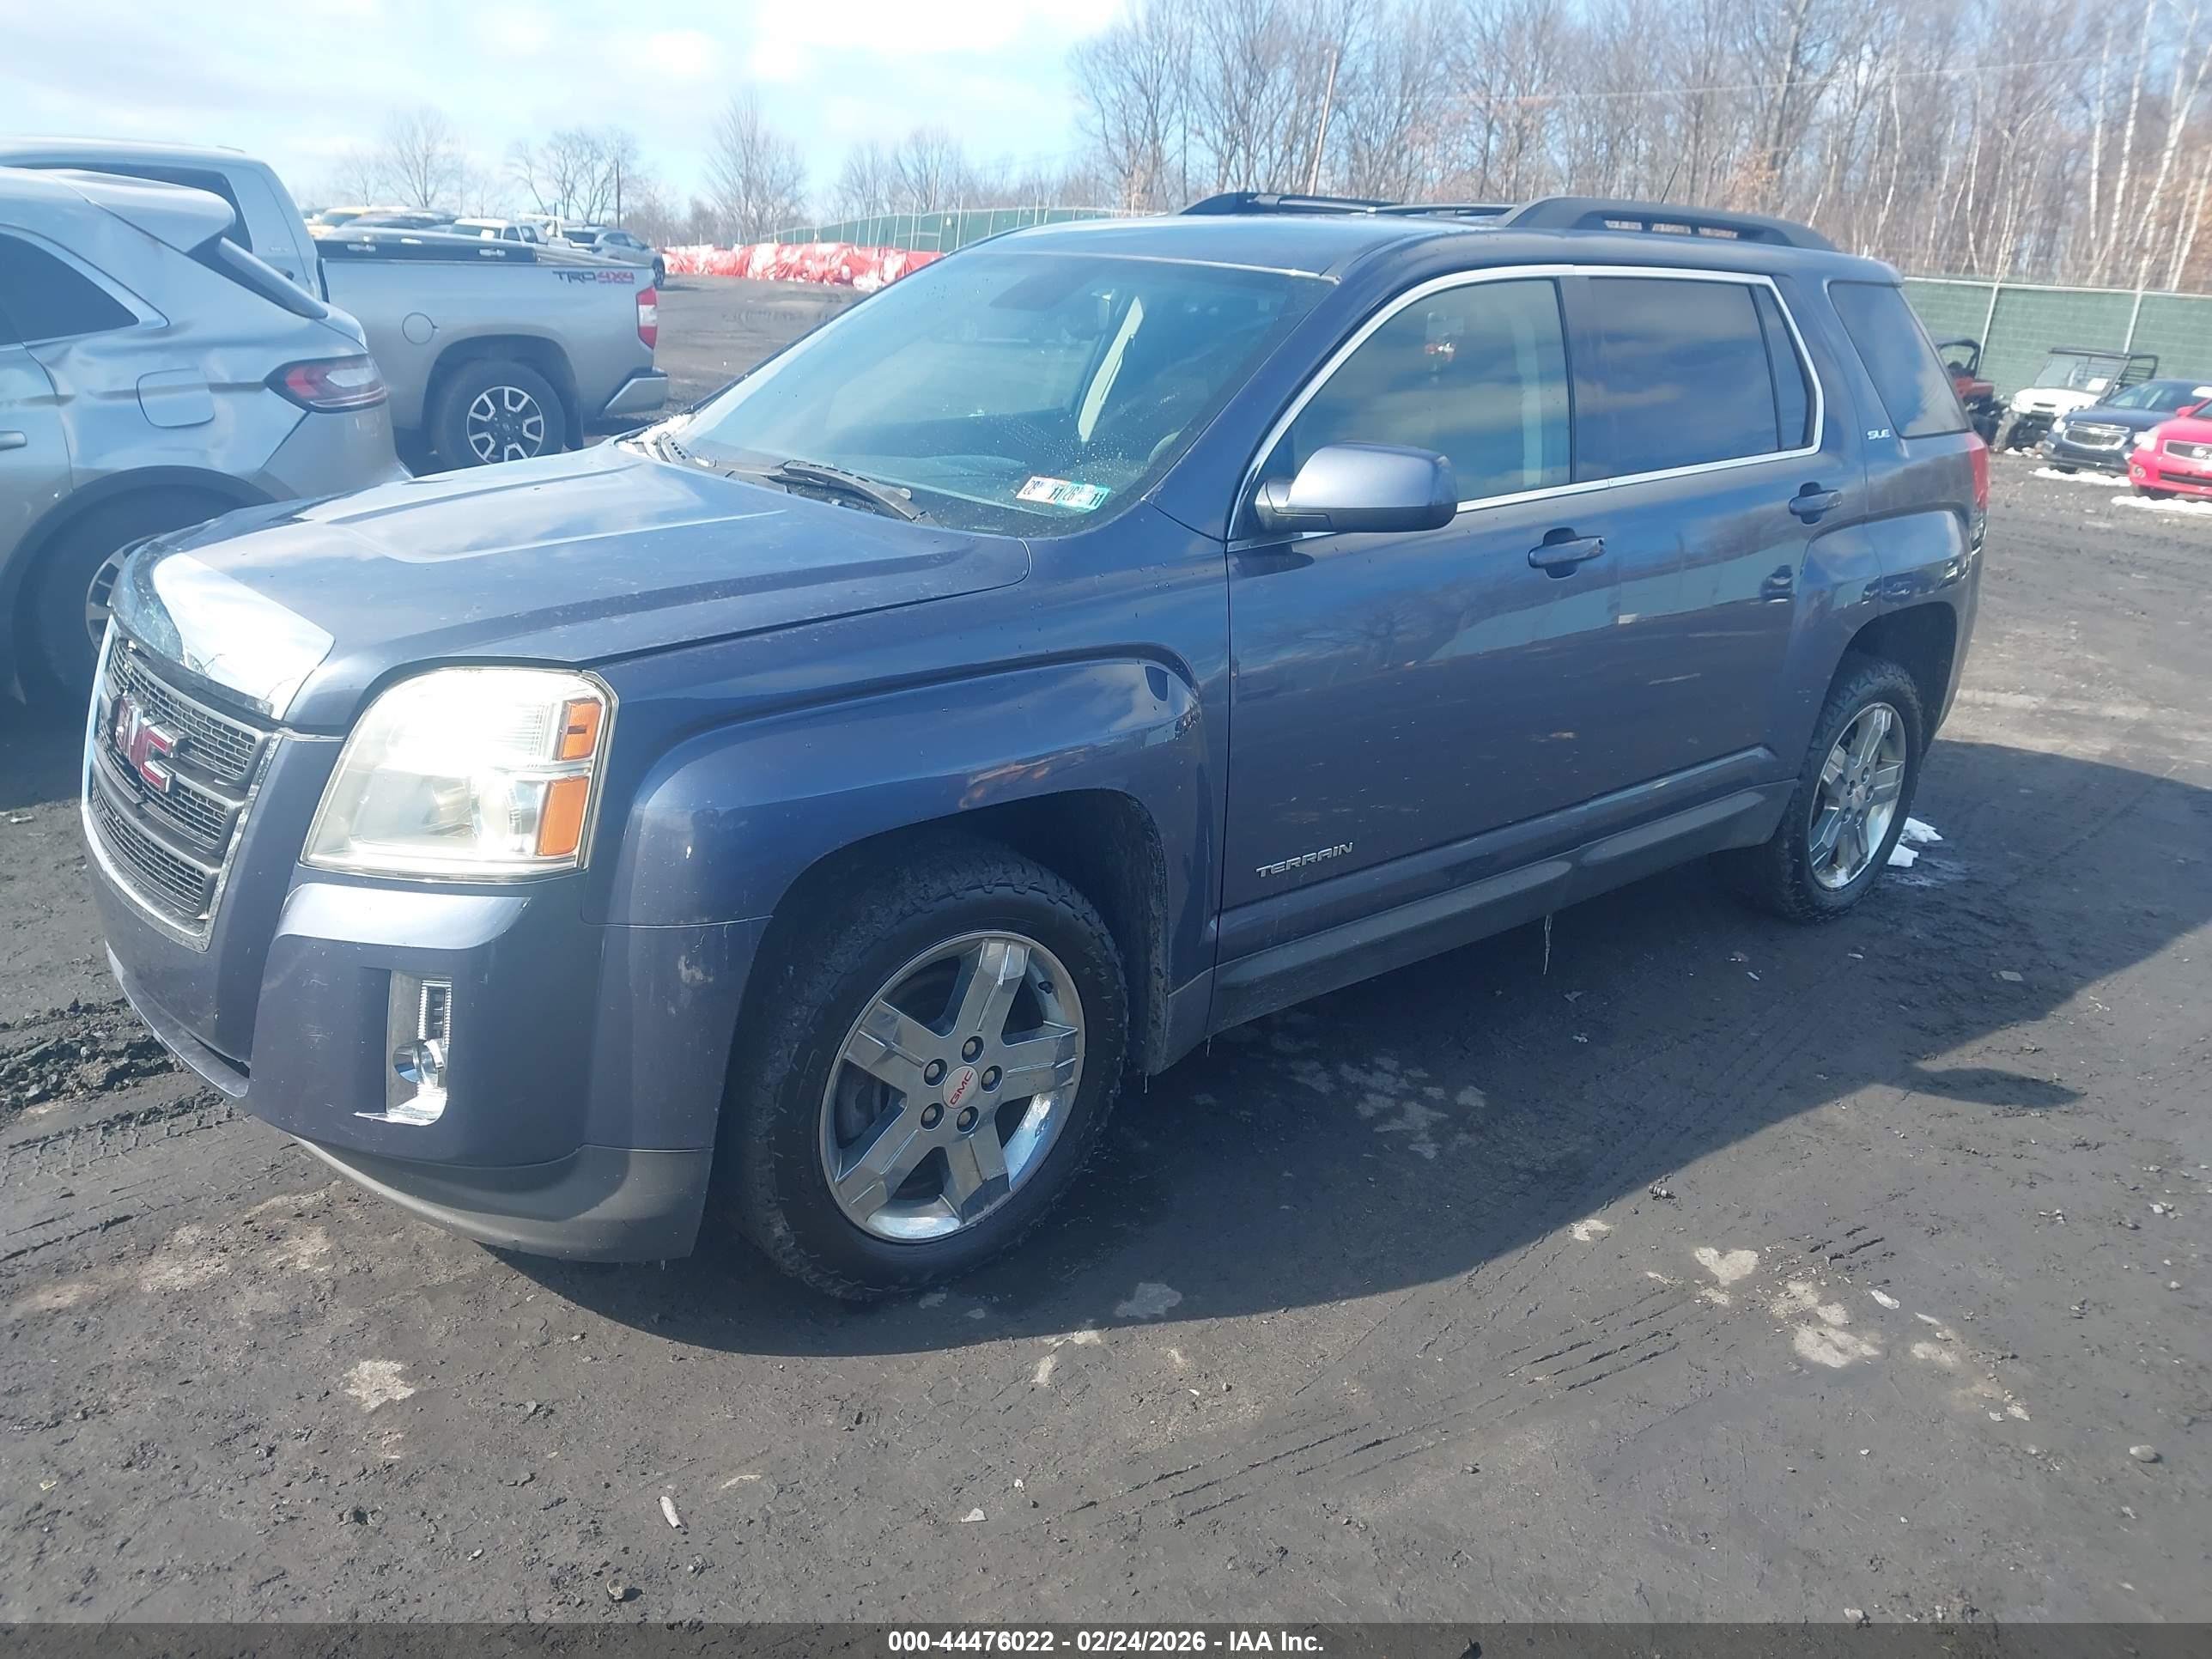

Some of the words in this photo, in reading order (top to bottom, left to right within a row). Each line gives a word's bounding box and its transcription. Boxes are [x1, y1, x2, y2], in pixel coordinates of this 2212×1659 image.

[552, 270, 597, 283] TRD
[1867, 428, 1891, 441] SLE
[1255, 842, 1353, 878] TERRAIN
[950, 1069, 974, 1105] GMC
